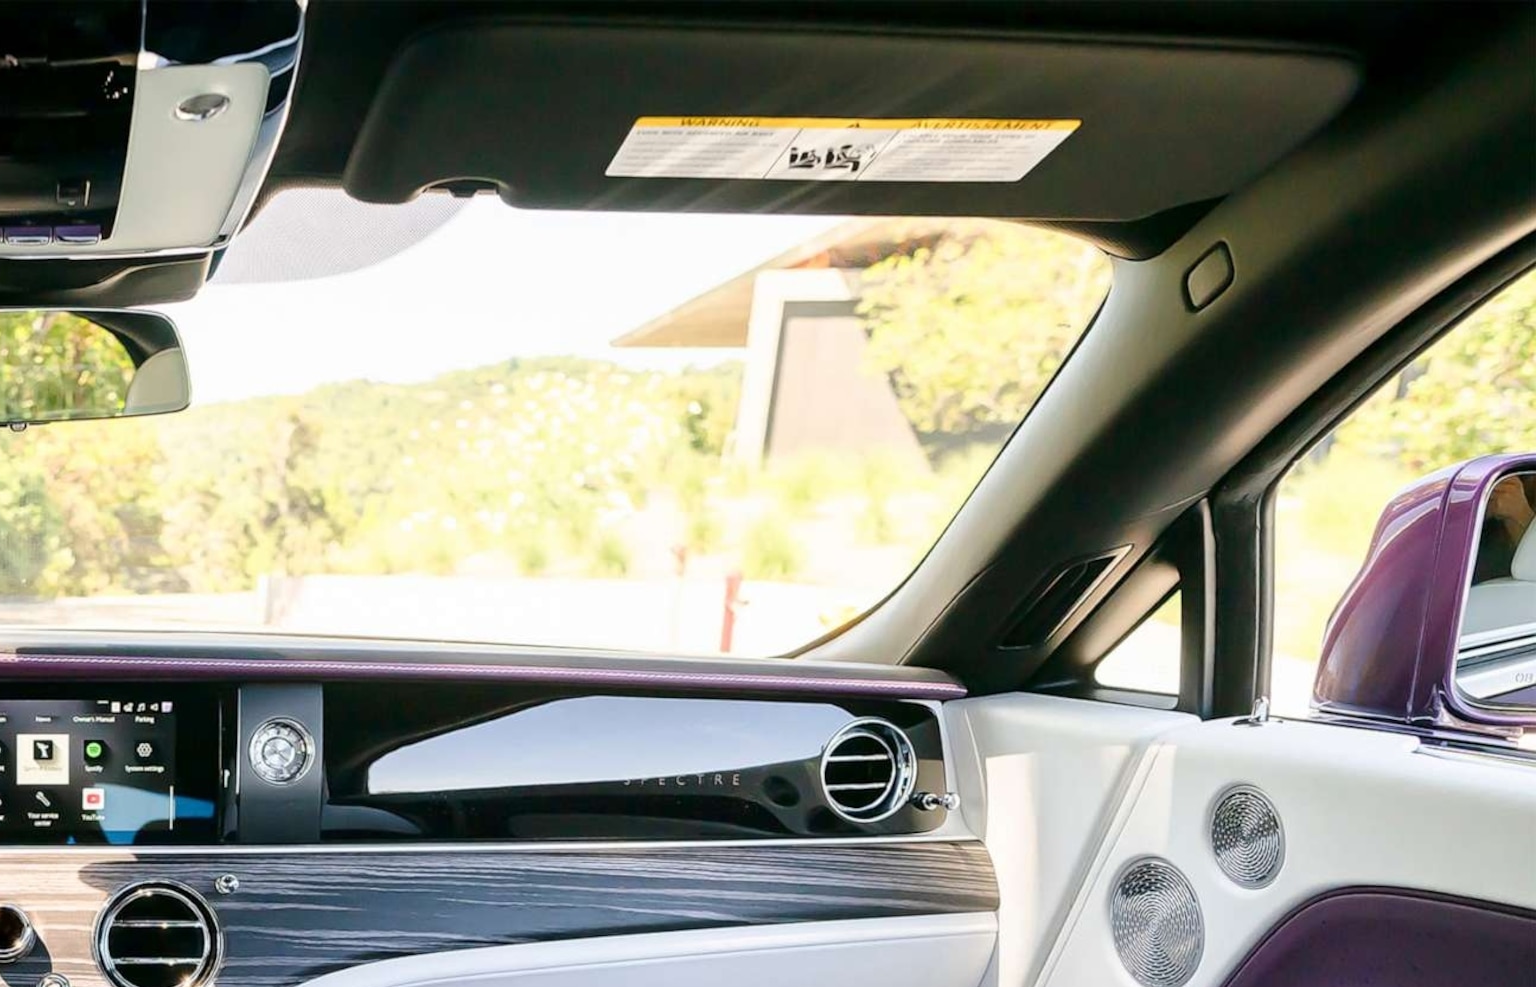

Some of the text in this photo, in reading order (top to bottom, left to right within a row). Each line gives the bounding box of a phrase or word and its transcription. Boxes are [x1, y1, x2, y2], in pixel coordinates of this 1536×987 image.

[681, 117, 761, 127] WARNING
[911, 120, 1052, 130] AVERTISSEMENT
[84, 765, 104, 773] Spotify
[81, 813, 106, 821] YouTube
